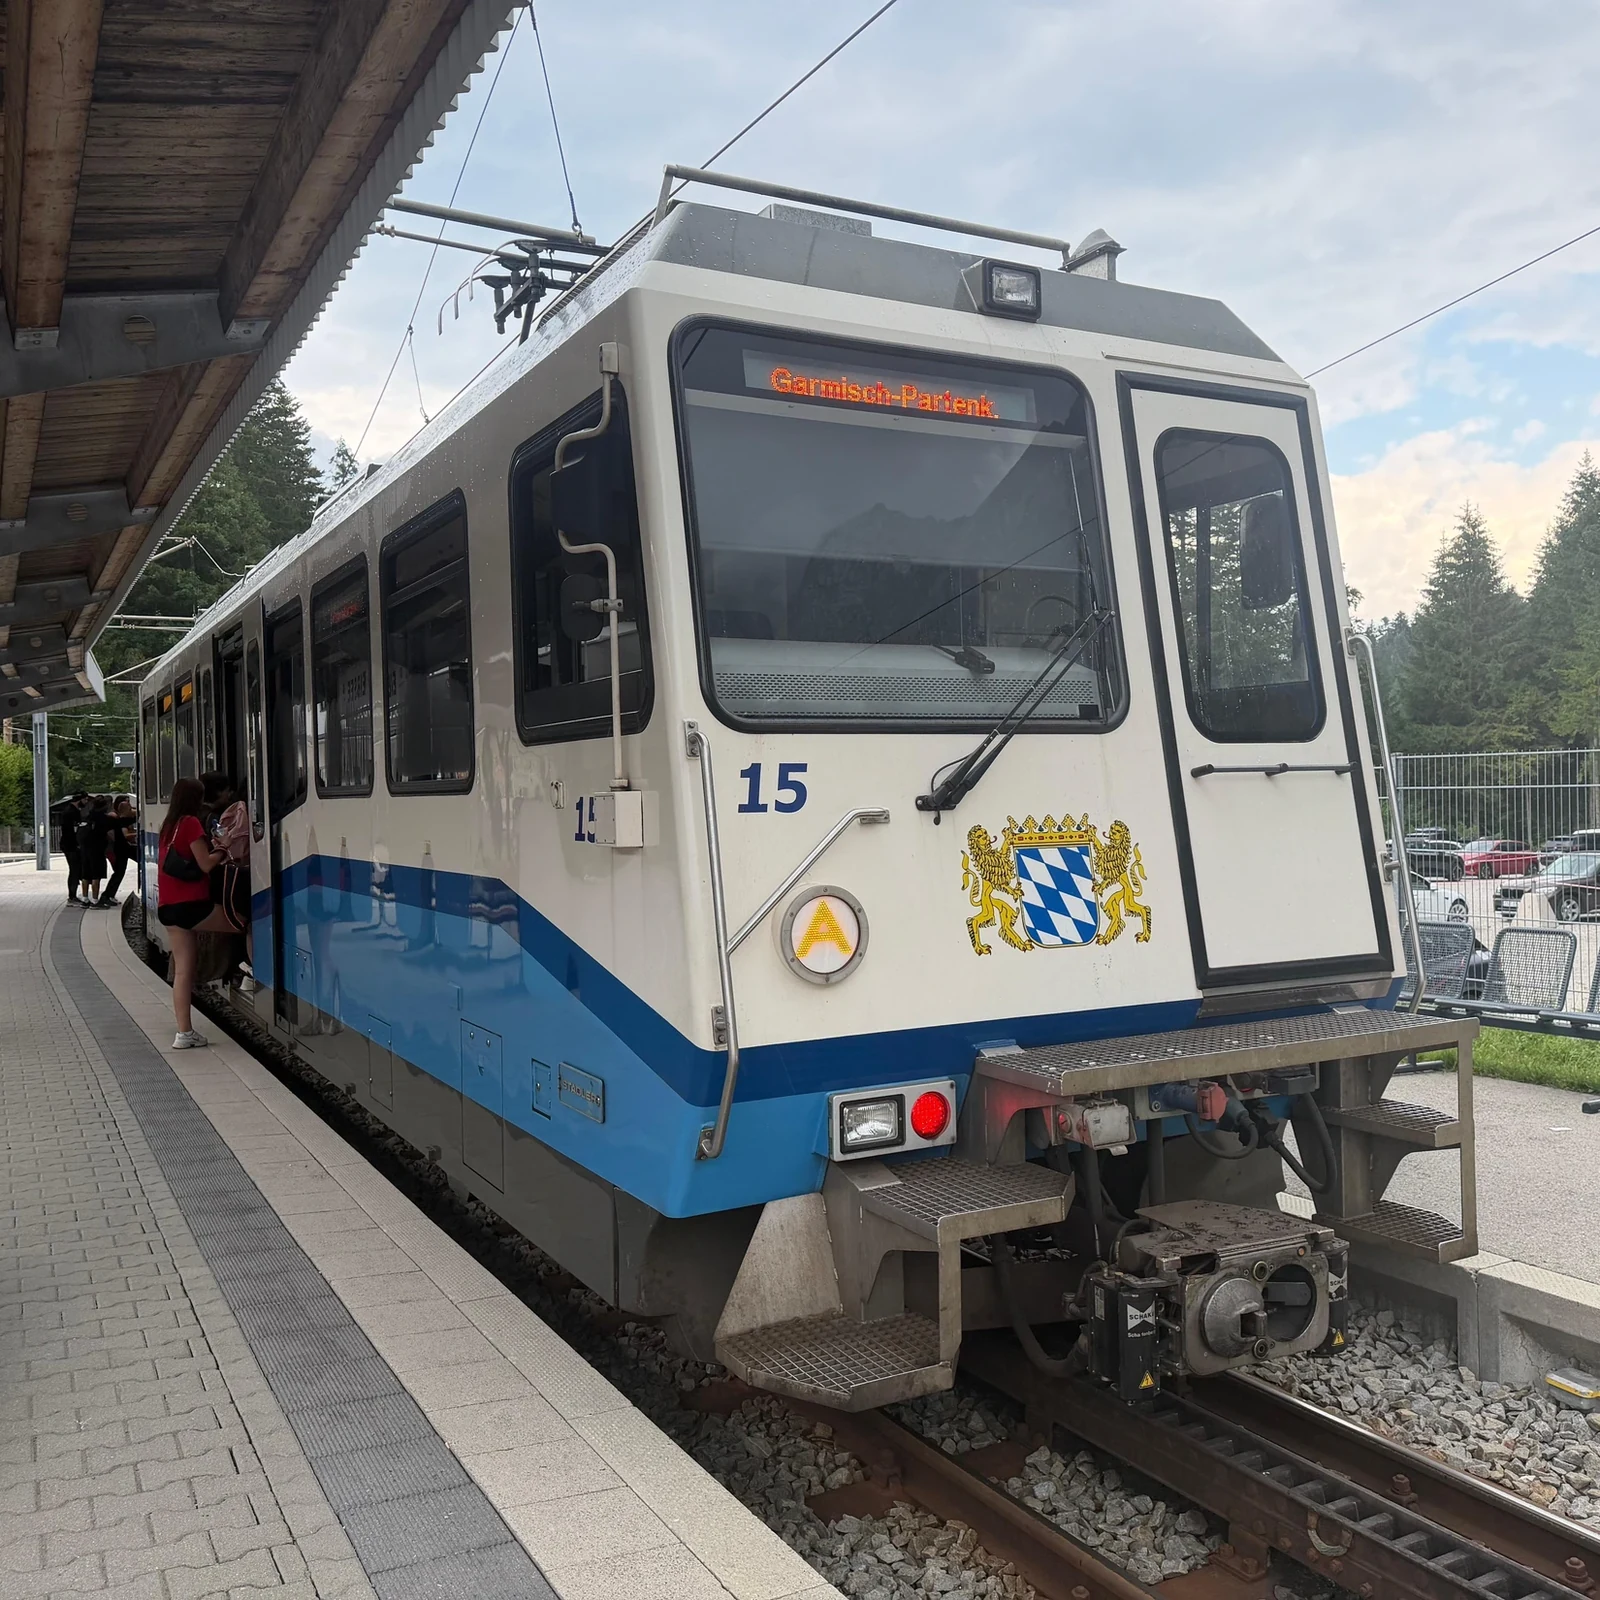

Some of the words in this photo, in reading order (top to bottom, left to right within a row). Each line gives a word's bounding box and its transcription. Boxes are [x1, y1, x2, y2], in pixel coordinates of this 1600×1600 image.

[770, 366, 1000, 419] Garmisch-Partenk.
[114, 756, 122, 765] B
[737, 762, 809, 814] 15
[795, 899, 852, 959] A
